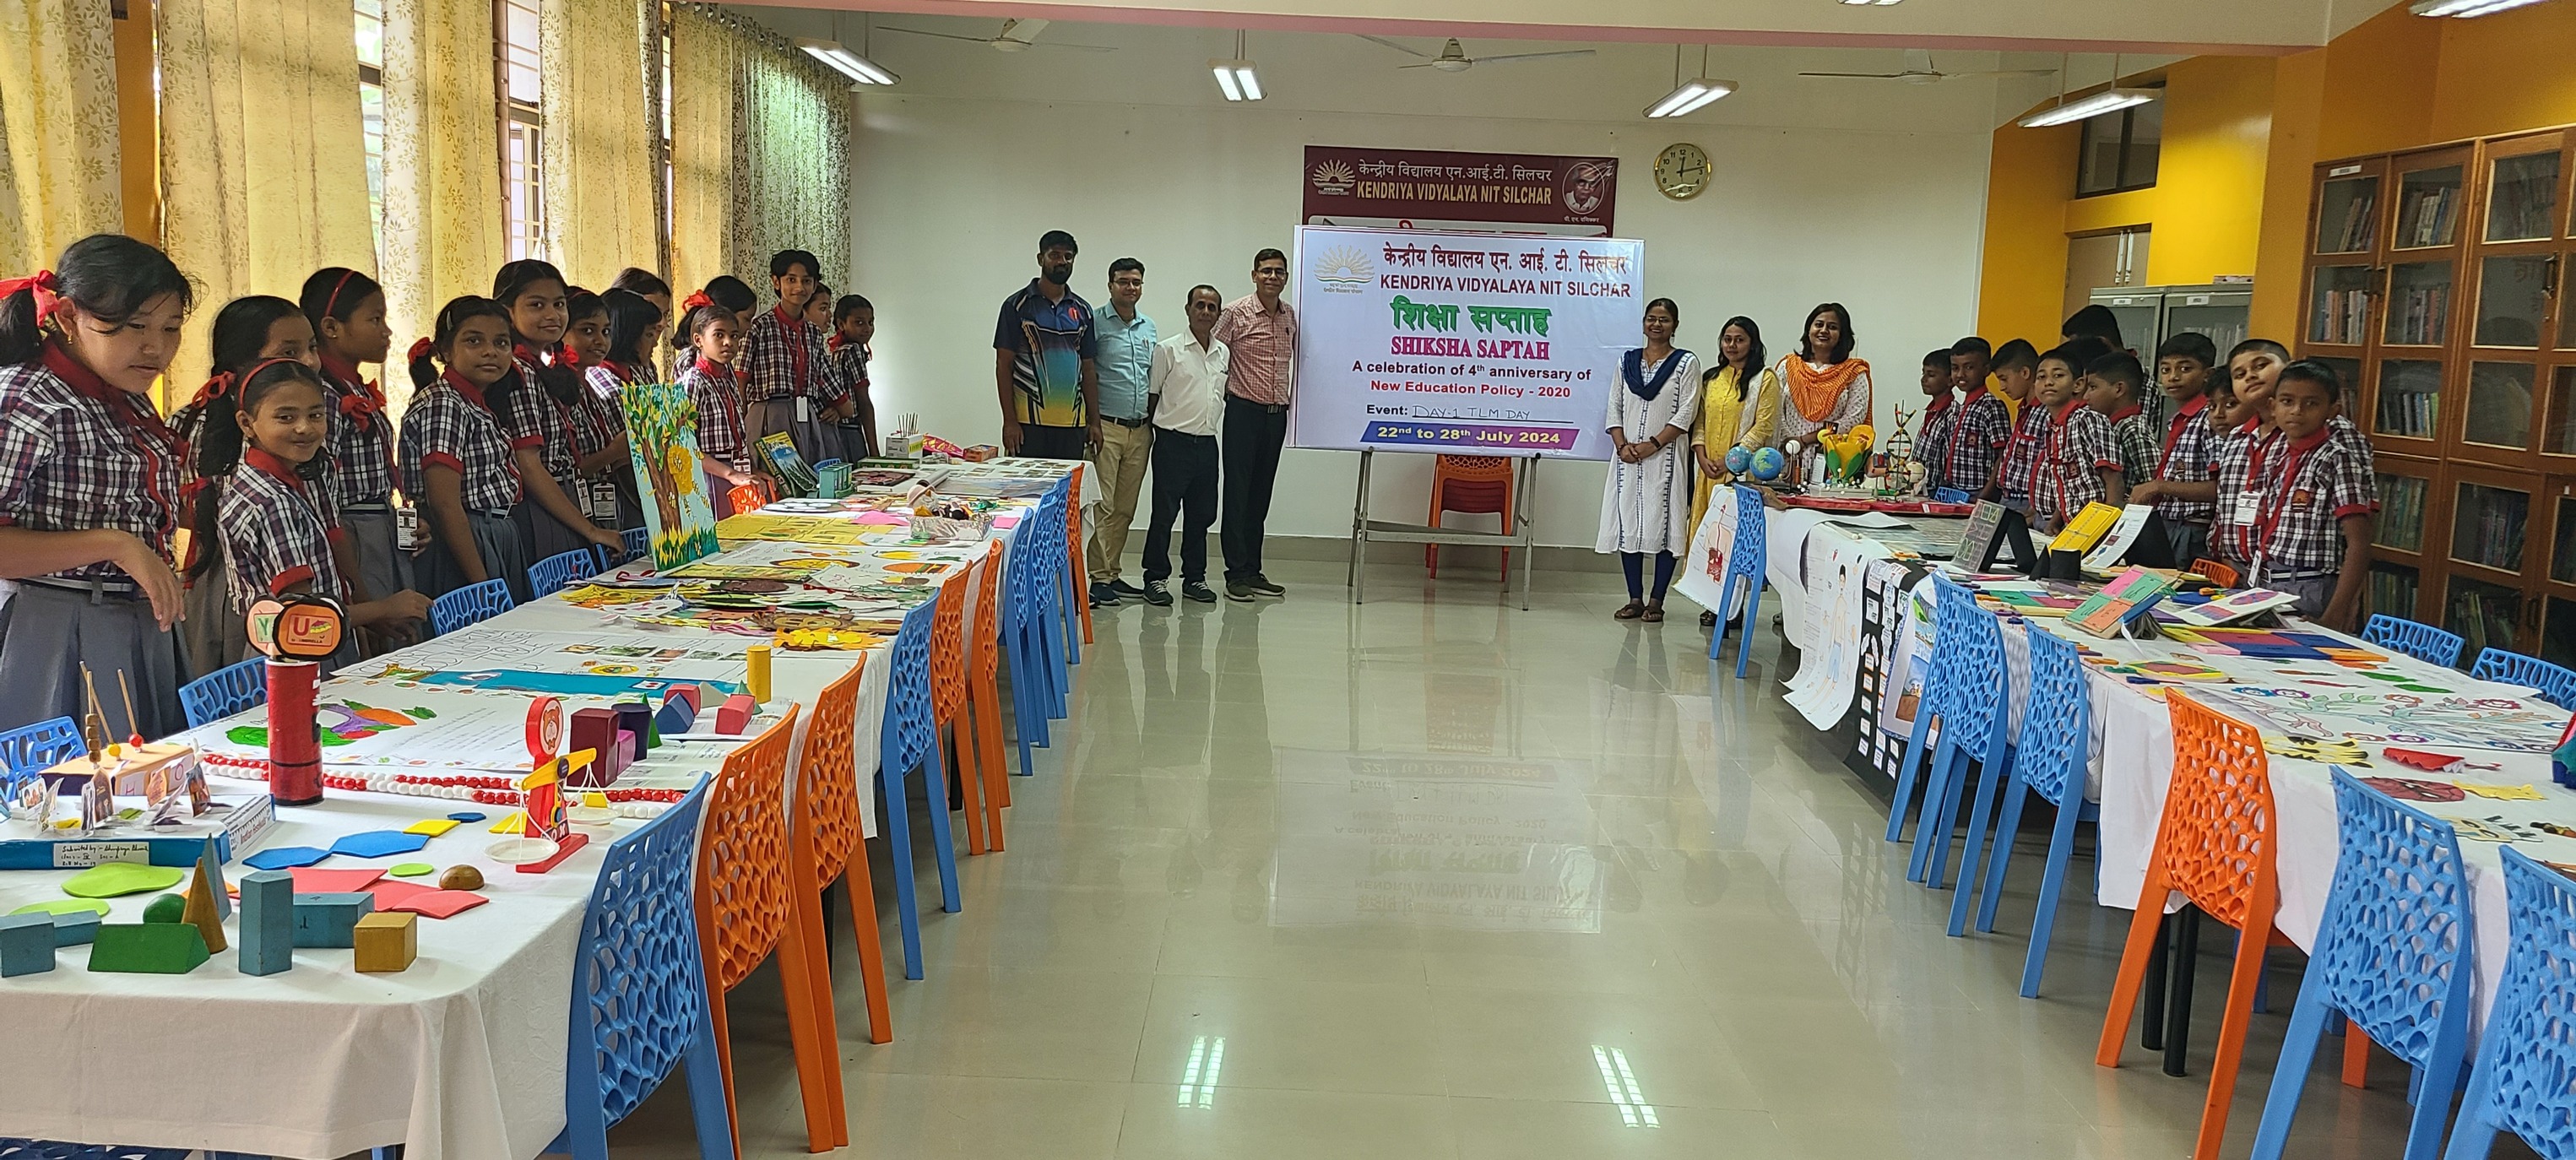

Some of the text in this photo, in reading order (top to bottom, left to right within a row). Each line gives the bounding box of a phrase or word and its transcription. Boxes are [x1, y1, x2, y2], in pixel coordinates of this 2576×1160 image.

[1358, 159, 1395, 179] केन्द्रीय
[1398, 160, 1443, 178] विद्यालय
[1512, 164, 1553, 182] सिलचर
[1357, 181, 1552, 205] KENDRIYA VIDYALAYA NIT SILCHAR
[1383, 241, 1628, 274] केन्द्रीय विद्यालय एन. आई. टी. सिलचर
[1380, 274, 1453, 291] KENDRIYA
[1457, 277, 1536, 294] VIDYALAYA
[1540, 280, 1563, 295] NIT
[1567, 281, 1631, 297] SILCHAR
[1390, 295, 1553, 338] शिक्षा सप्ताह
[1391, 336, 1550, 360] SHIKSHA SAPTAH
[1352, 360, 1592, 382] A celebration of 4th anniversary of
[1371, 380, 1401, 391] New
[1405, 382, 1476, 393] Education
[1481, 384, 1524, 398] Policy
[1537, 387, 1570, 398] 2020
[1366, 404, 1408, 415] Event:
[1467, 408, 1499, 418] TLM
[1505, 409, 1531, 420] DAY
[1377, 426, 1560, 444] 22nd to 28th July 2024
[258, 618, 269, 636] Y
[293, 617, 310, 637] U
